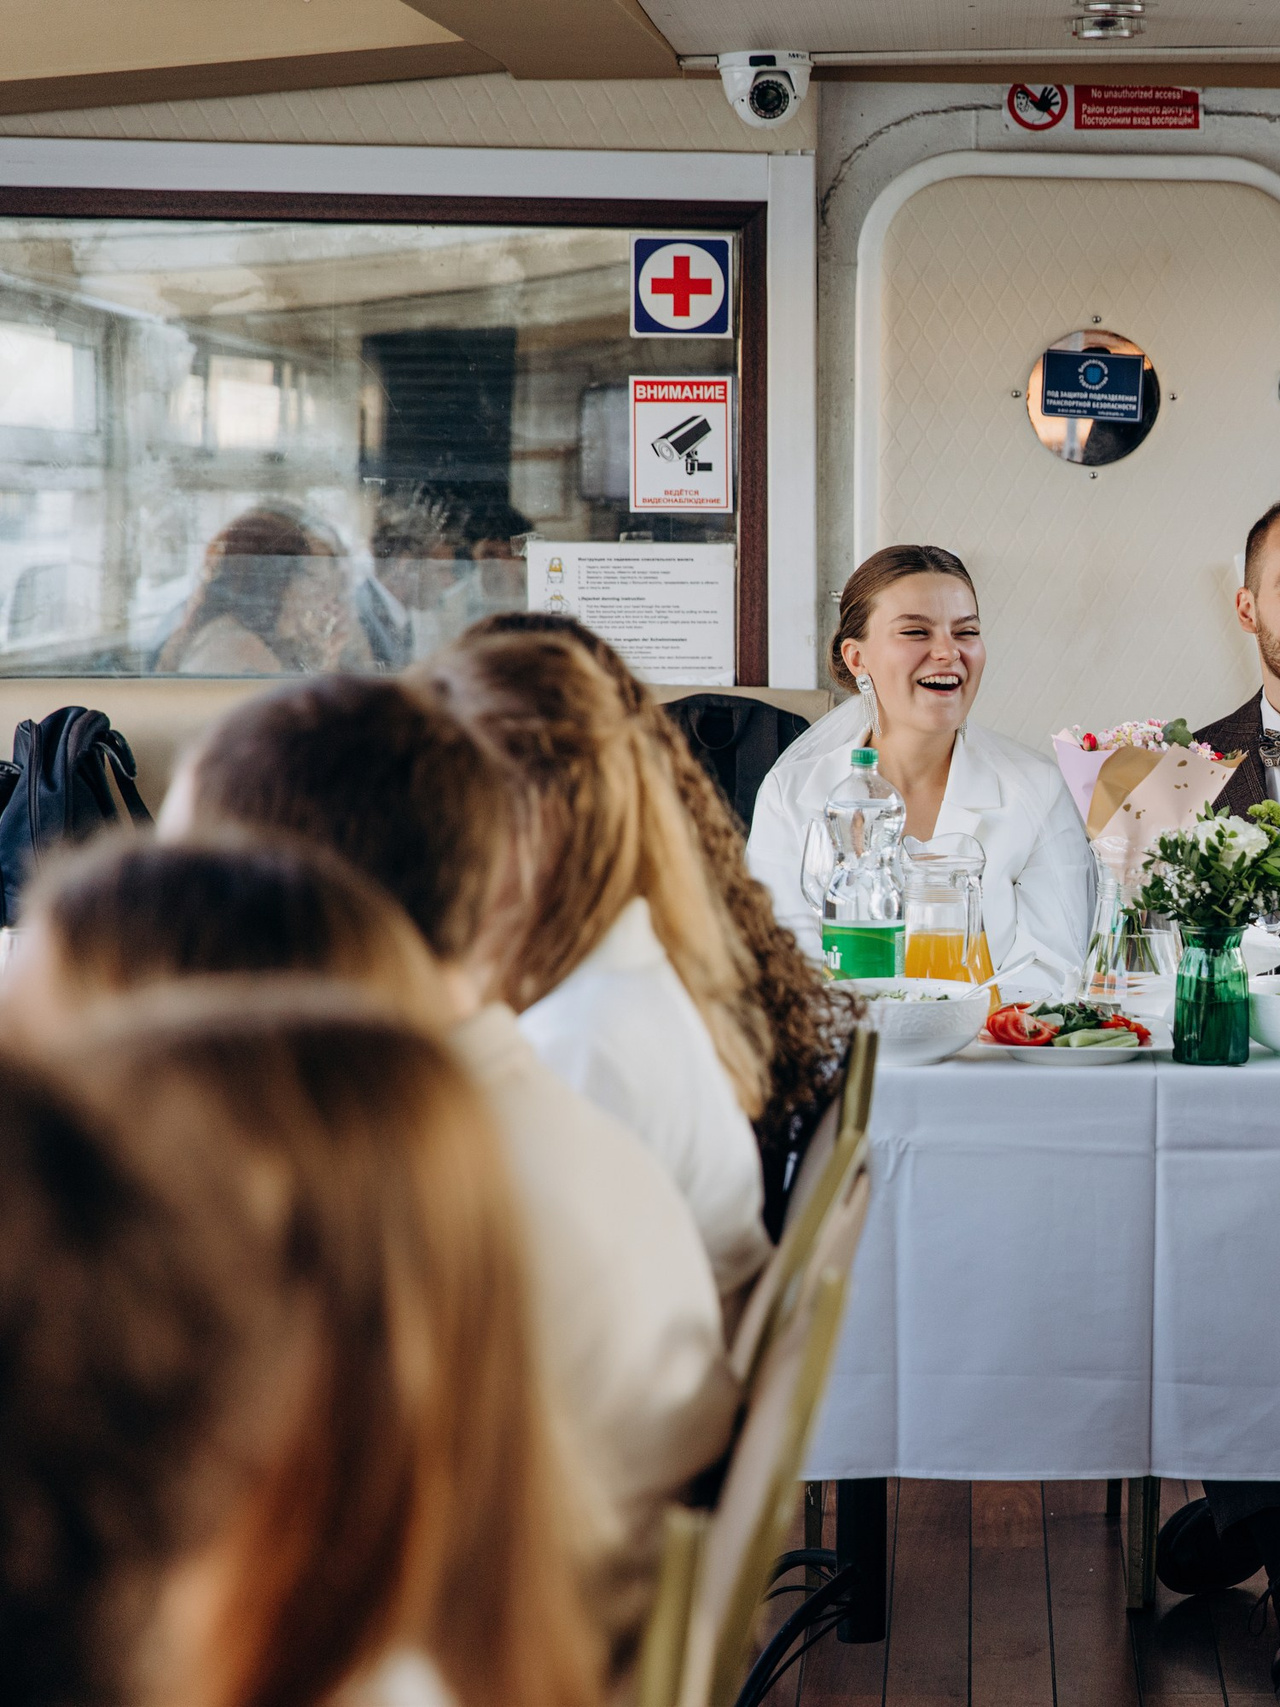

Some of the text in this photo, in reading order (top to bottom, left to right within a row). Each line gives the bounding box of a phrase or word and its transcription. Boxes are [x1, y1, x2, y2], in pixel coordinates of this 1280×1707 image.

[1091, 89, 1102, 98] No
[1104, 89, 1153, 99] unauthorized
[1082, 103, 1104, 113] Район
[1106, 106, 1160, 115] ограниченного
[1082, 115, 1131, 126] Посторонним
[1132, 117, 1150, 126] вход
[636, 384, 725, 400] ВНИМАНИЕ
[1046, 390, 1138, 402] ПОД ЗАЩИТОЙ ПОДРАЗДЕЛЕНИЯ
[1046, 399, 1137, 411] ТРАНСПОРТНОЙ БЕЗОПАСНОСТИ
[663, 488, 699, 496] ВЕДЁТСЯ
